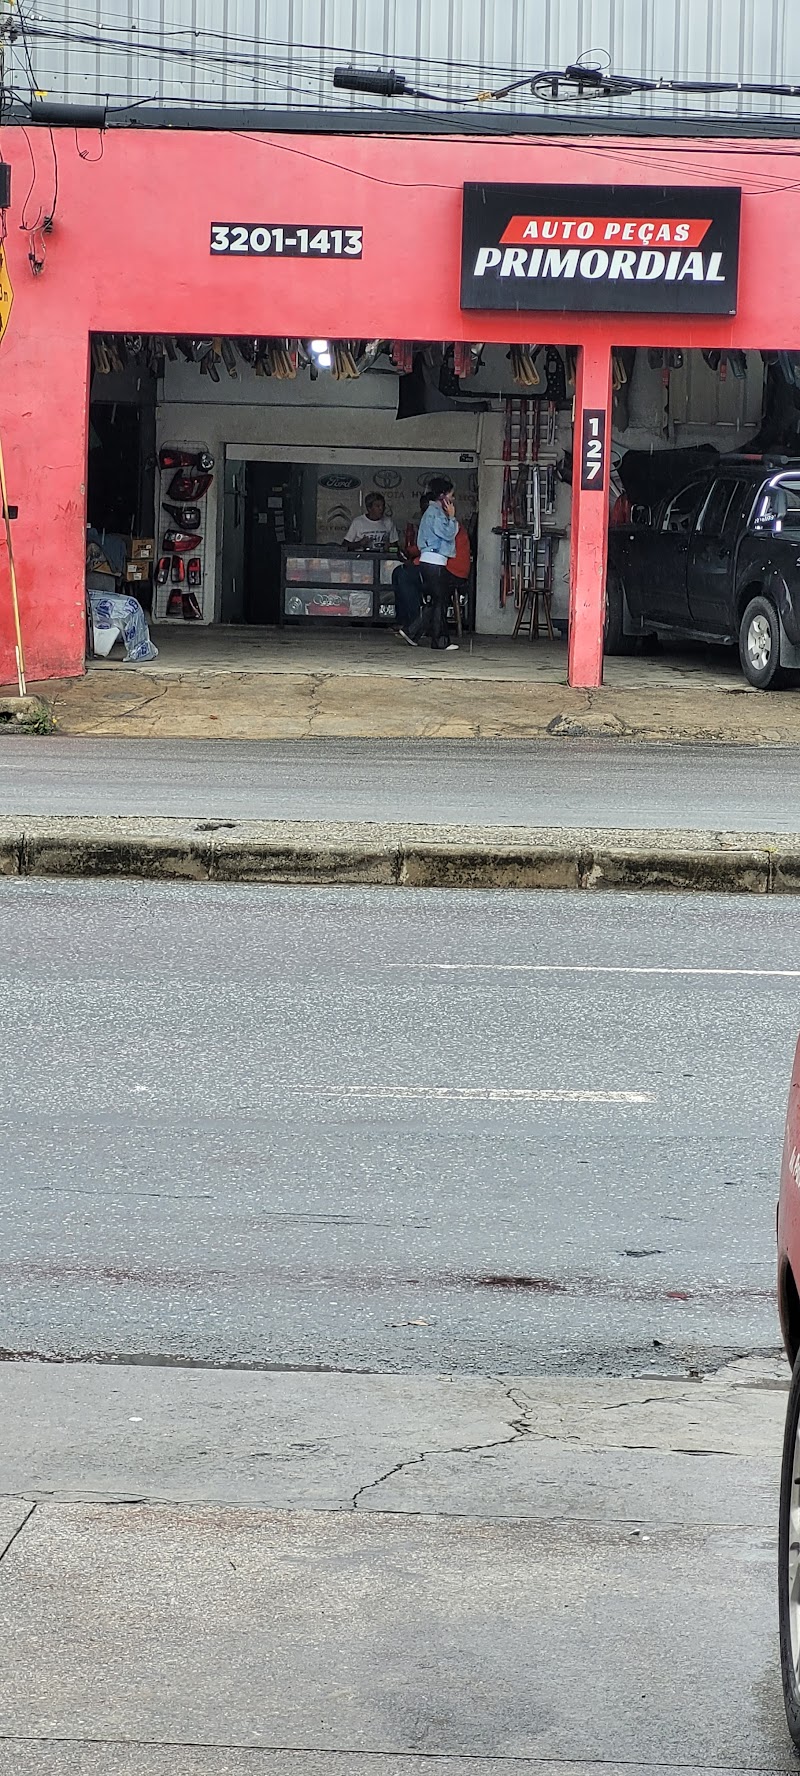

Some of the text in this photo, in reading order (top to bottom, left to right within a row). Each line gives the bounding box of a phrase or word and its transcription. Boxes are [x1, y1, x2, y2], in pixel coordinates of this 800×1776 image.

[210, 226, 363, 255] 3201-1413
[522, 220, 691, 245] AUTO PEÇAS
[473, 247, 726, 282] PRIMORDIAL
[586, 417, 602, 480] 127
